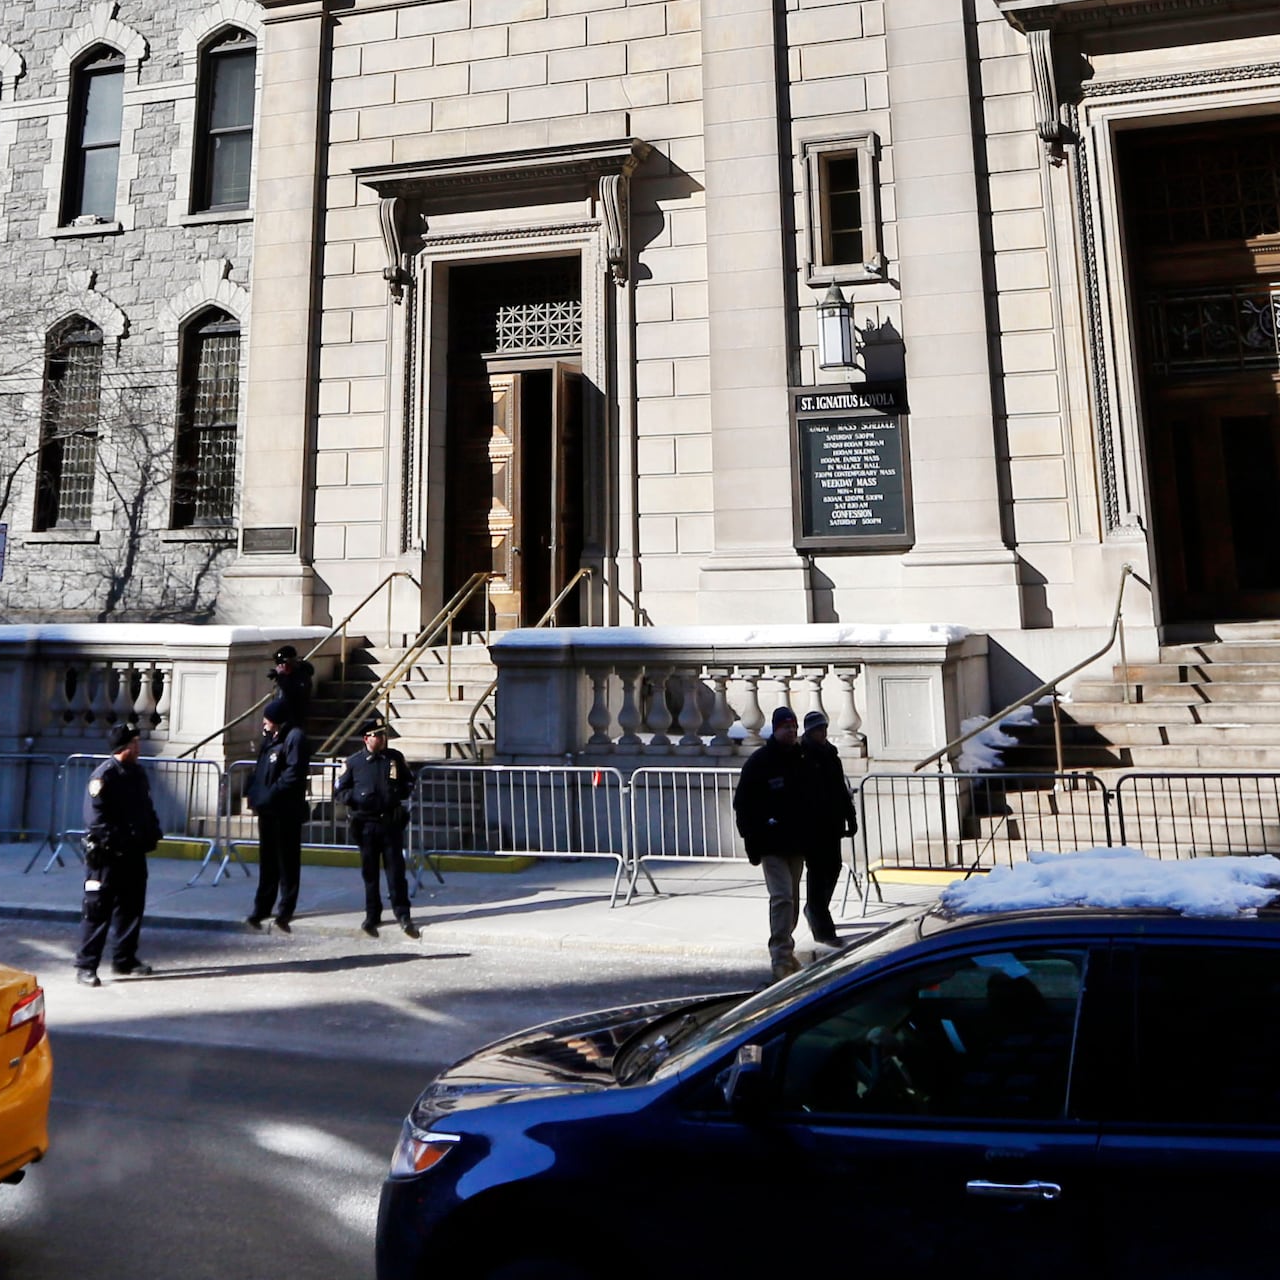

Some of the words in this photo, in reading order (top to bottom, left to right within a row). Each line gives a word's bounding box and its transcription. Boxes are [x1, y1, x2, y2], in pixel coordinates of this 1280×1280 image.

[801, 397, 815, 410] ST.
[816, 394, 858, 410] IGNATIUS
[859, 392, 895, 407] LOYOLA
[825, 433, 853, 441] SATURDAY
[833, 470, 877, 478] CONTEMPORARY
[879, 468, 896, 476] MASS
[821, 479, 853, 488] WEEKDAY
[856, 478, 877, 486] MASS
[831, 509, 873, 519] CONFESSION
